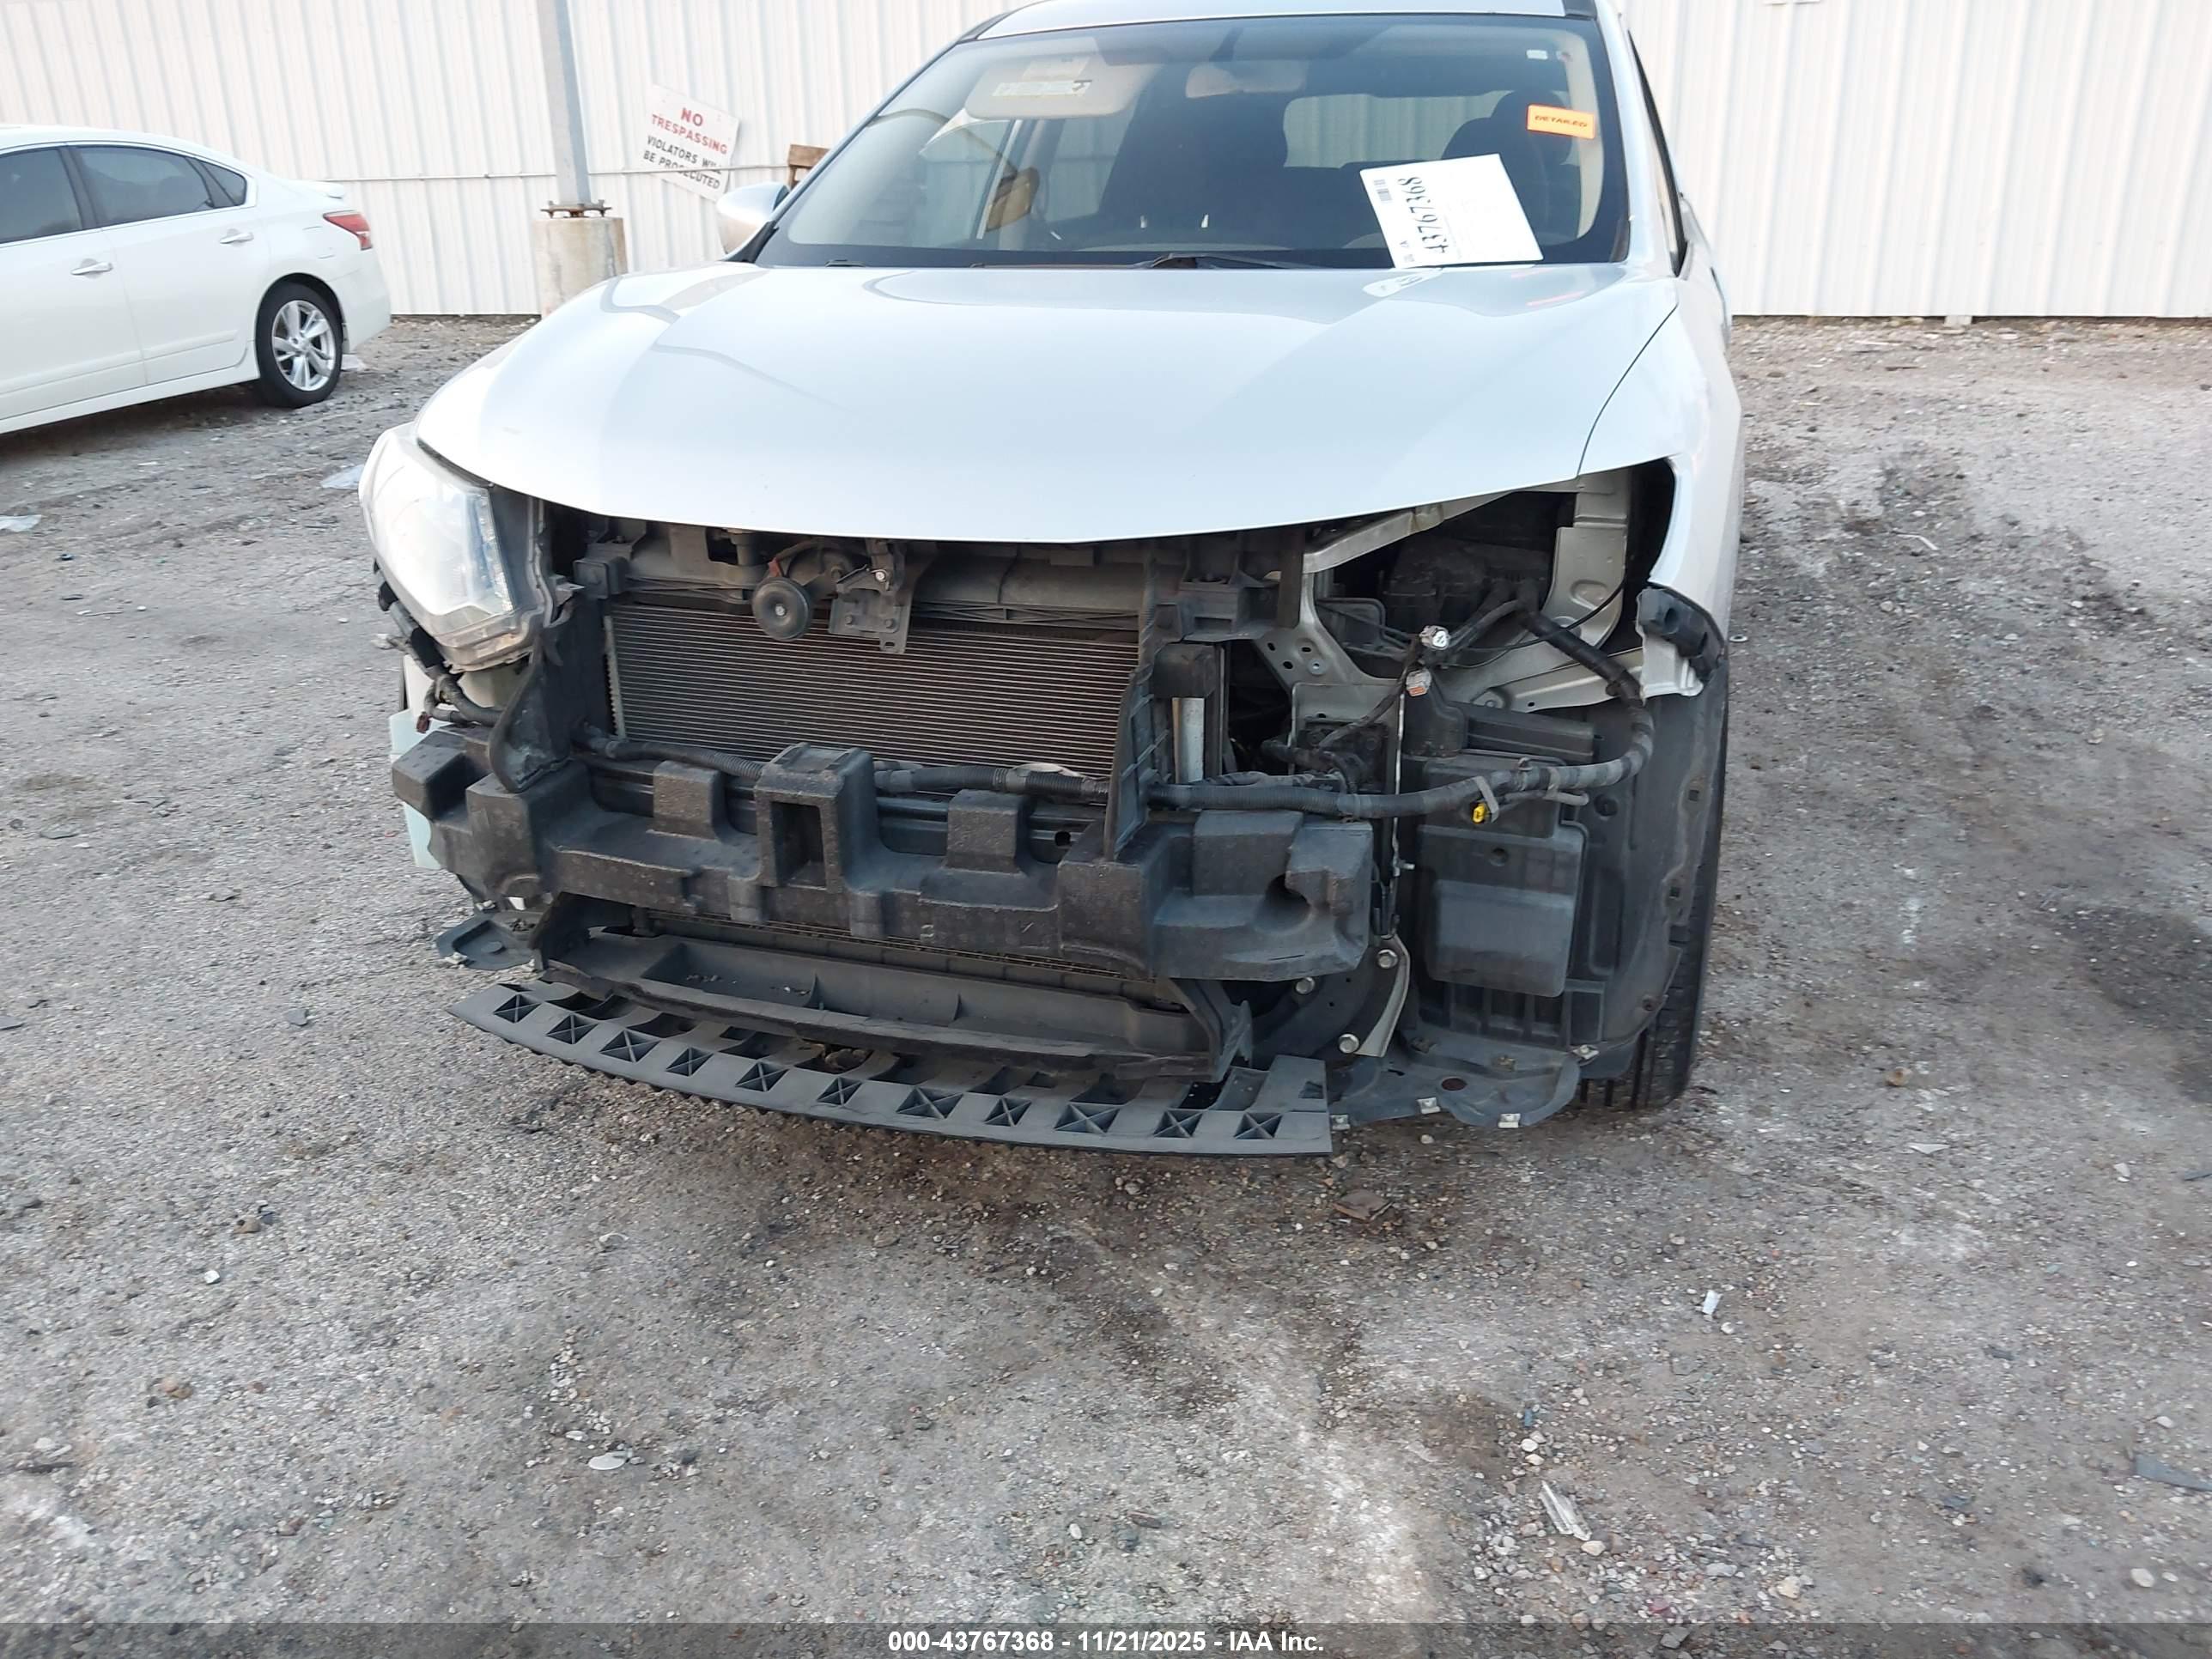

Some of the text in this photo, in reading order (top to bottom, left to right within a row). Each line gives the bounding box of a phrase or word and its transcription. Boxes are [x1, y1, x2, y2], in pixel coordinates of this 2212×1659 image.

[681, 108, 703, 126] NO
[652, 114, 727, 155] TRESPASSING
[644, 150, 655, 163] BE
[647, 135, 698, 164] VIOLATORS
[1397, 177, 1449, 253] 43767368
